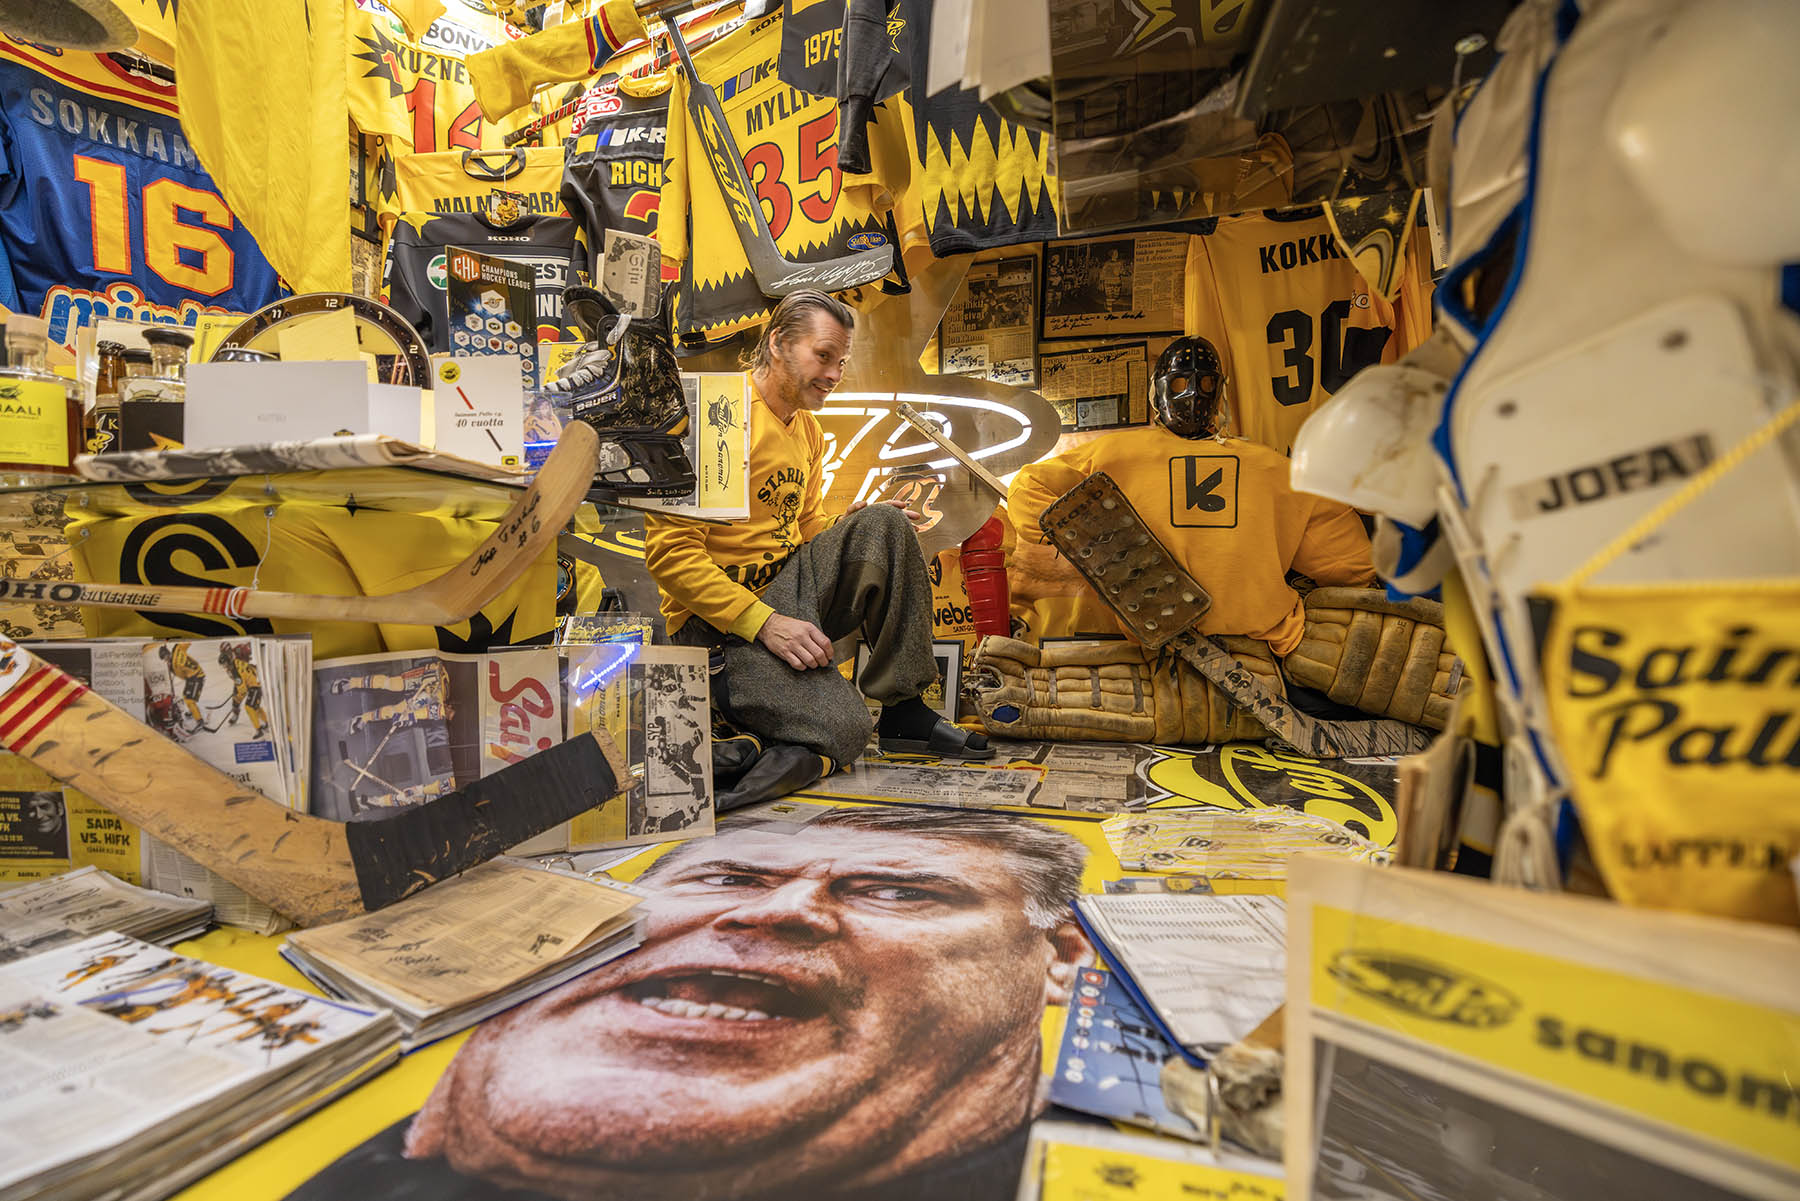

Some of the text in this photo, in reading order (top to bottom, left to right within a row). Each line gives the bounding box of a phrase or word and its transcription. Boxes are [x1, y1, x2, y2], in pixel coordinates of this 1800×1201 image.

[393, 42, 472, 87] KUZNE
[755, 53, 781, 84] K-
[742, 101, 843, 242] 35
[73, 153, 235, 297] 16
[1259, 232, 1352, 274] KOKK
[454, 256, 480, 281] CHL
[481, 263, 519, 280] CHAMPIONS
[481, 273, 532, 291] HOCKEY LEAGUE
[324, 298, 338, 308] 12
[271, 309, 282, 319] 11
[377, 311, 383, 320] 1
[409, 344, 418, 354] 2
[0, 404, 42, 417] AALI
[471, 417, 504, 427] vuotta
[1537, 444, 1688, 514] JOFA
[0, 580, 83, 603] HO
[87, 818, 122, 831] SAIPA
[80, 832, 131, 847] VS. HIFK
